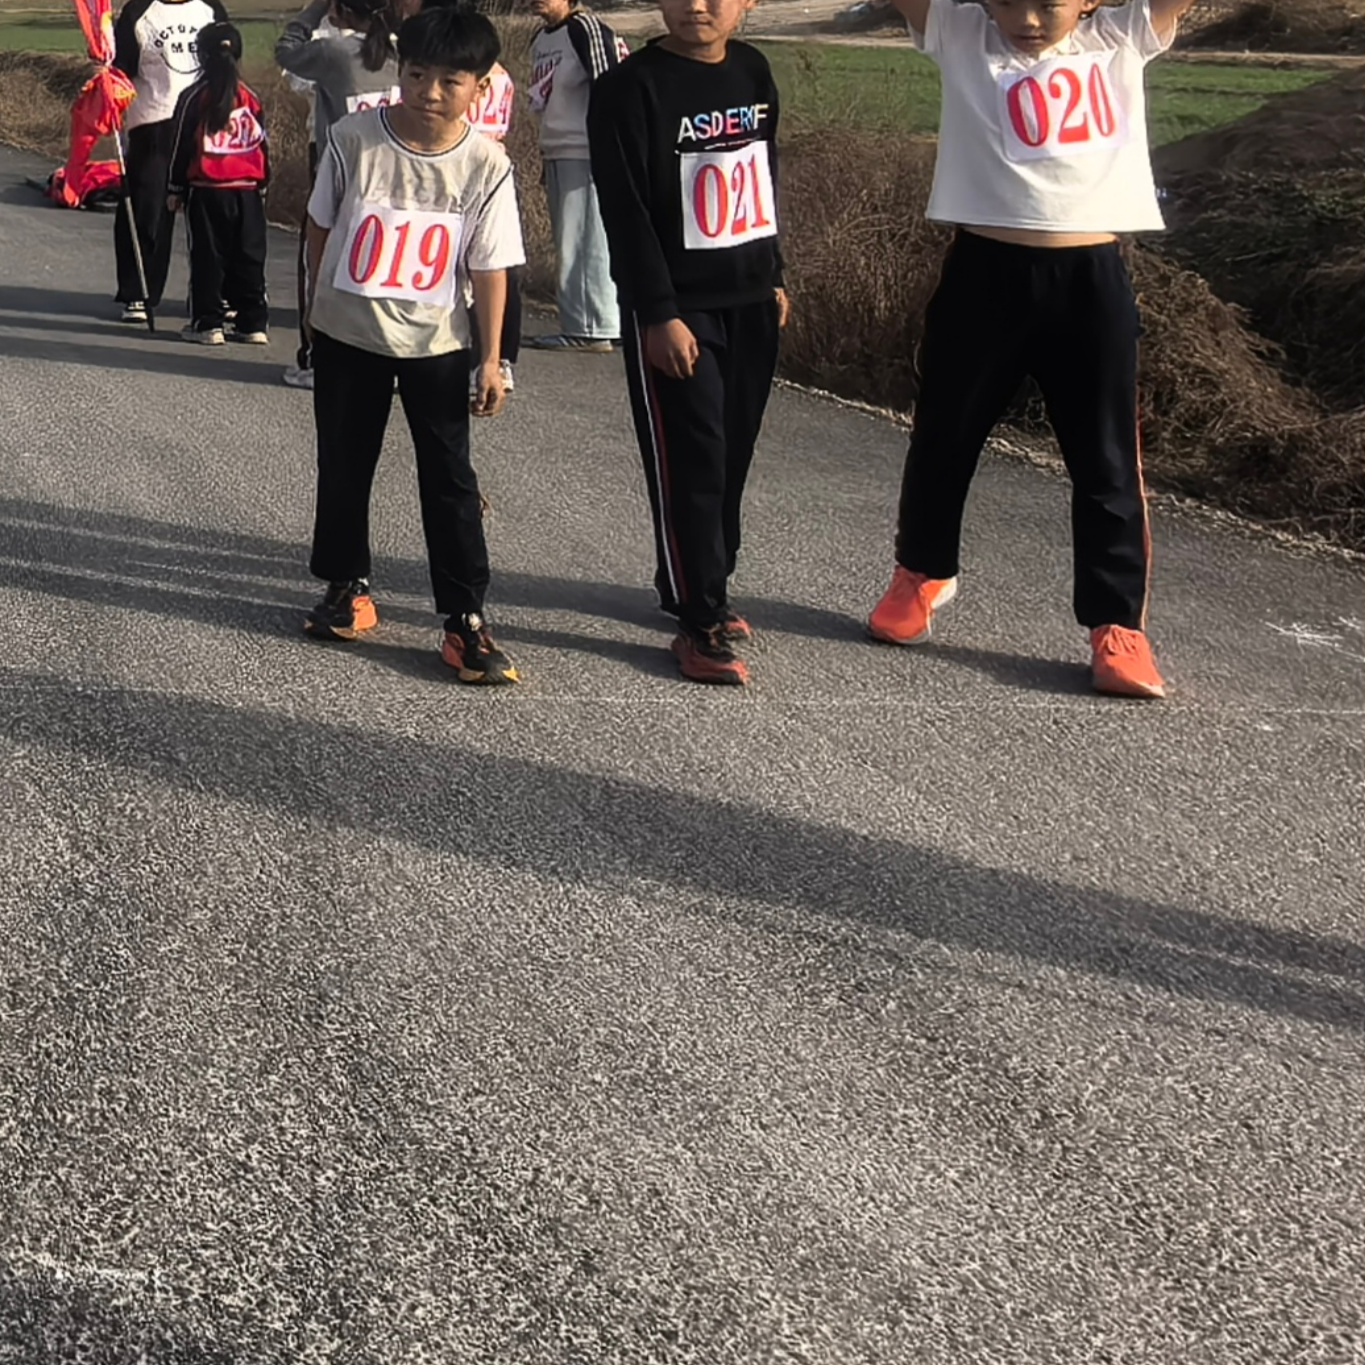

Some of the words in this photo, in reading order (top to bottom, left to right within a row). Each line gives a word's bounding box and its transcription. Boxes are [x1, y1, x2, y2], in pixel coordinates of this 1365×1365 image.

[1007, 63, 1115, 146] 020
[693, 153, 771, 238] 021
[349, 214, 450, 291] 019
